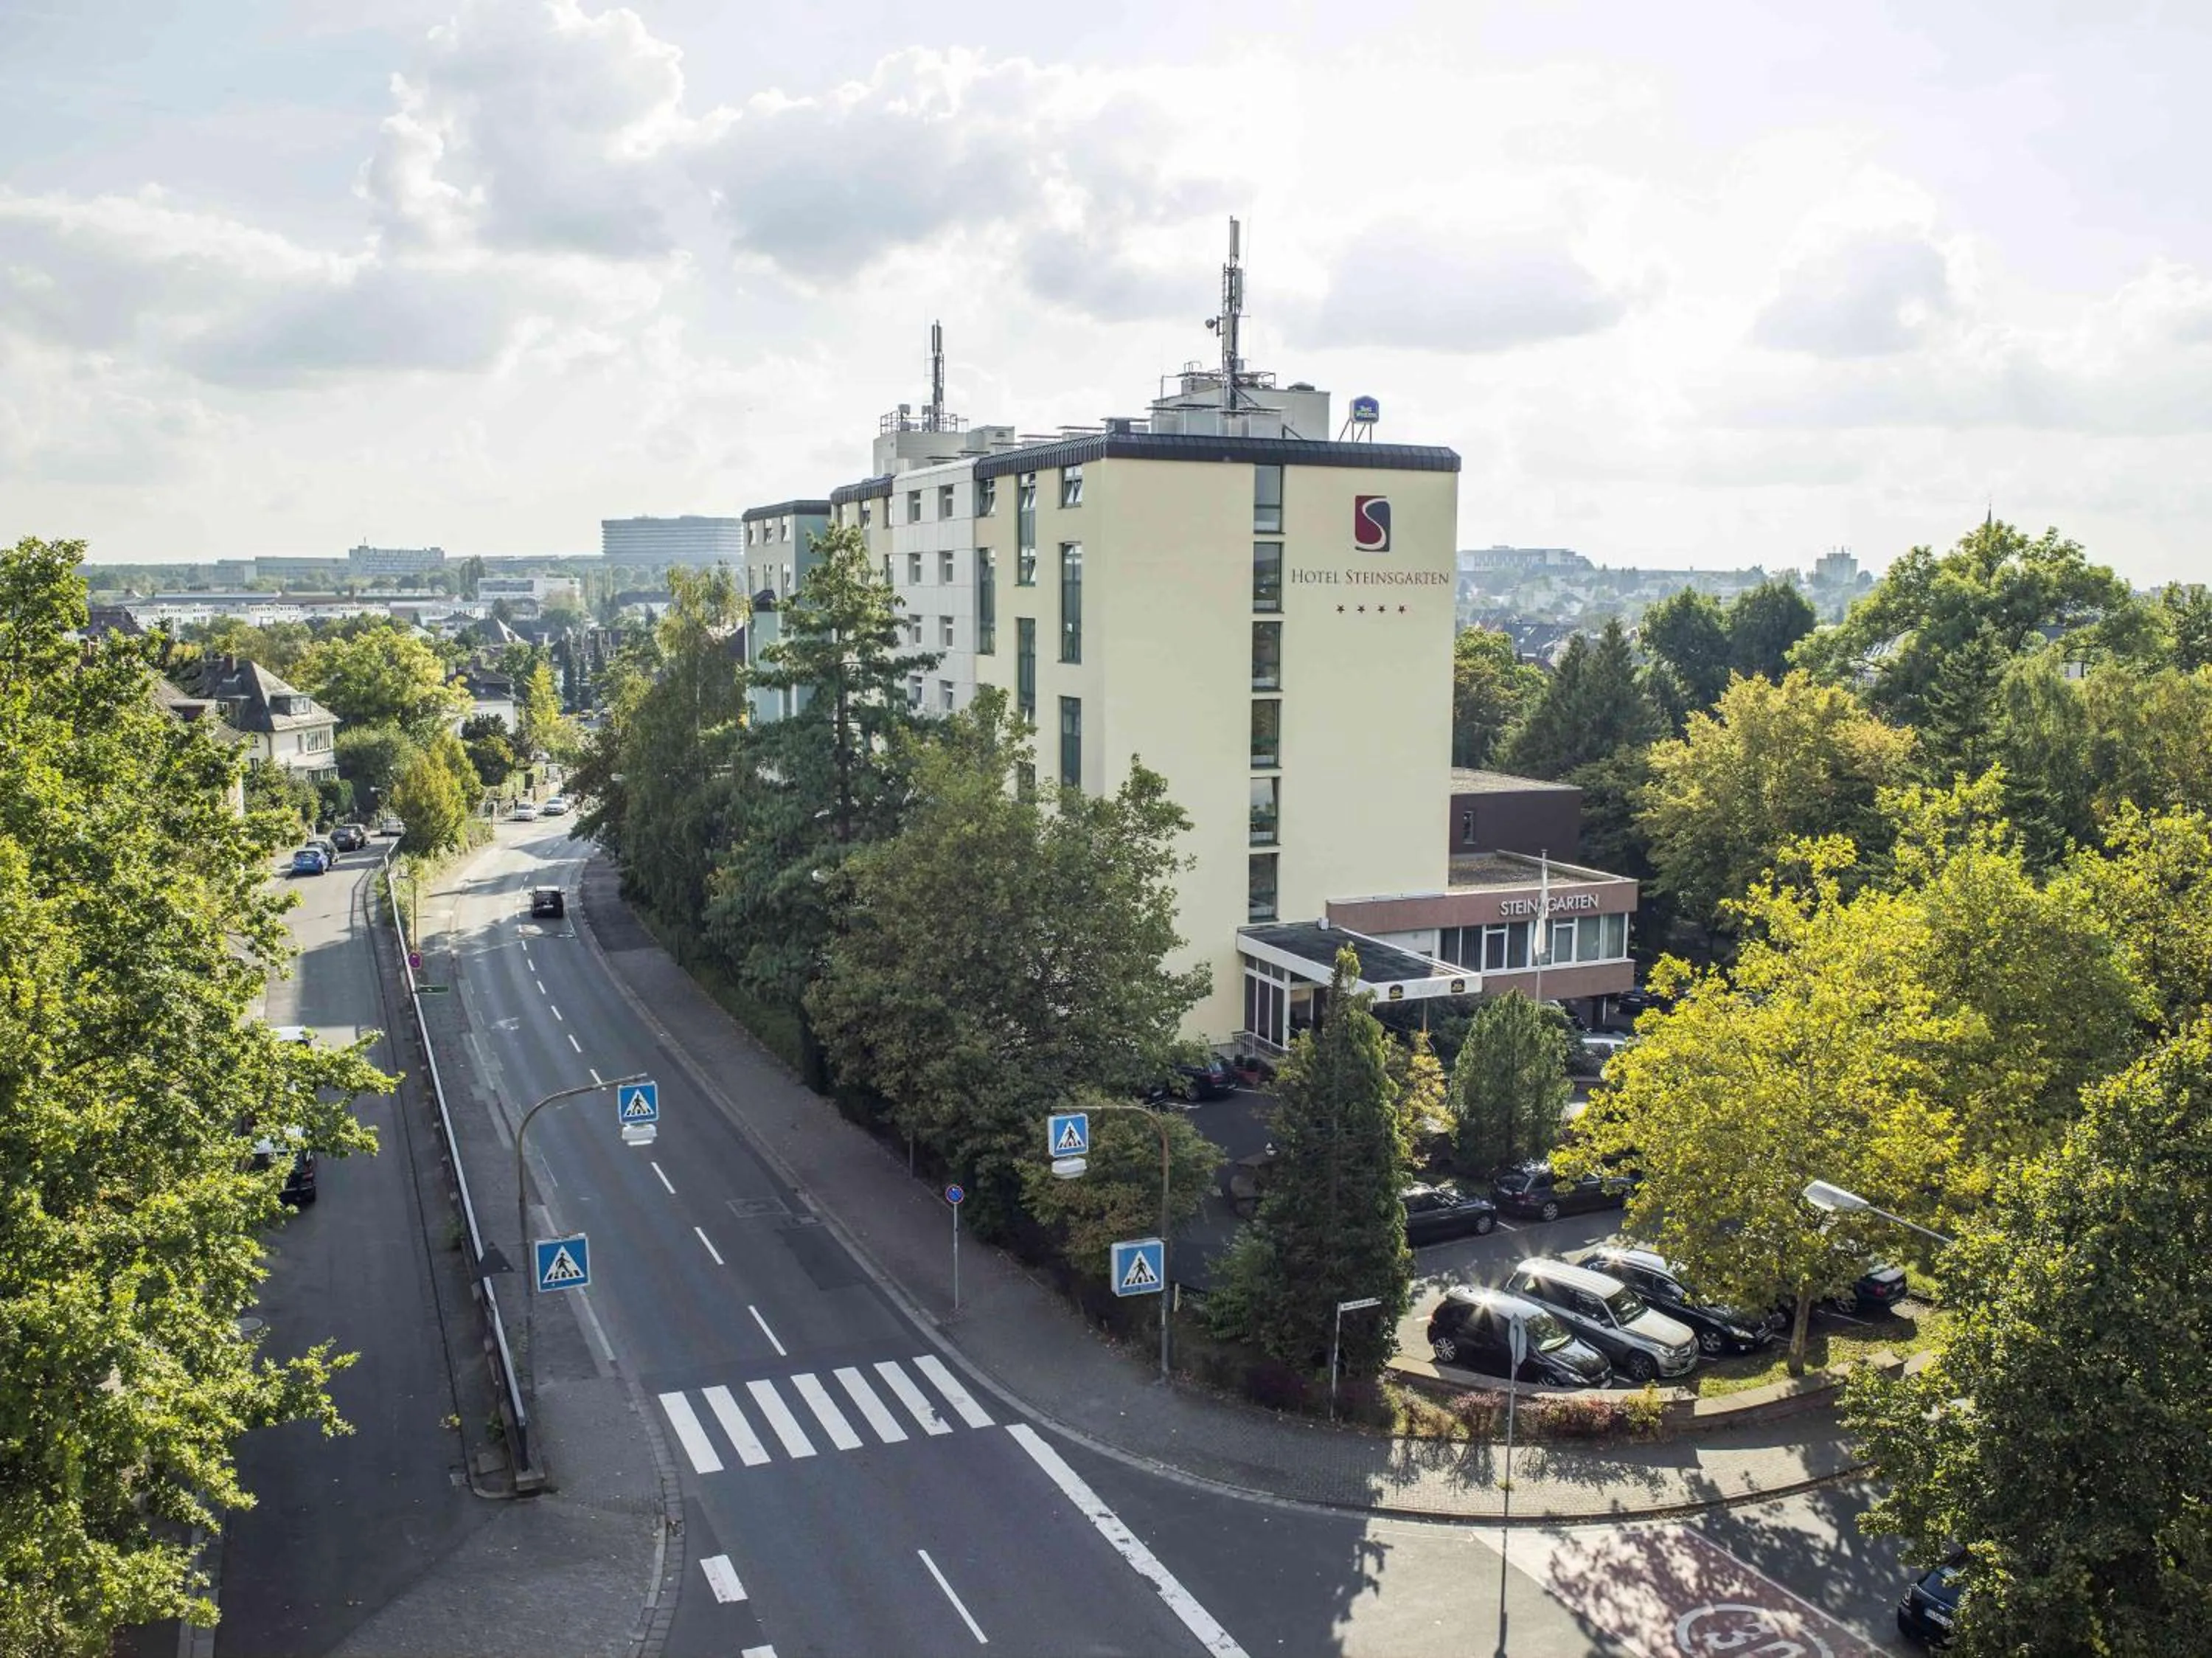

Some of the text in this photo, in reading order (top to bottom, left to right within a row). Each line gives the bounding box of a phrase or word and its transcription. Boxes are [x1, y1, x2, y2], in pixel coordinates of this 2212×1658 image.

[1291, 569, 1449, 585] HOTEL STEINSGARTEN
[1500, 893, 1599, 915] STEINGARTEN
